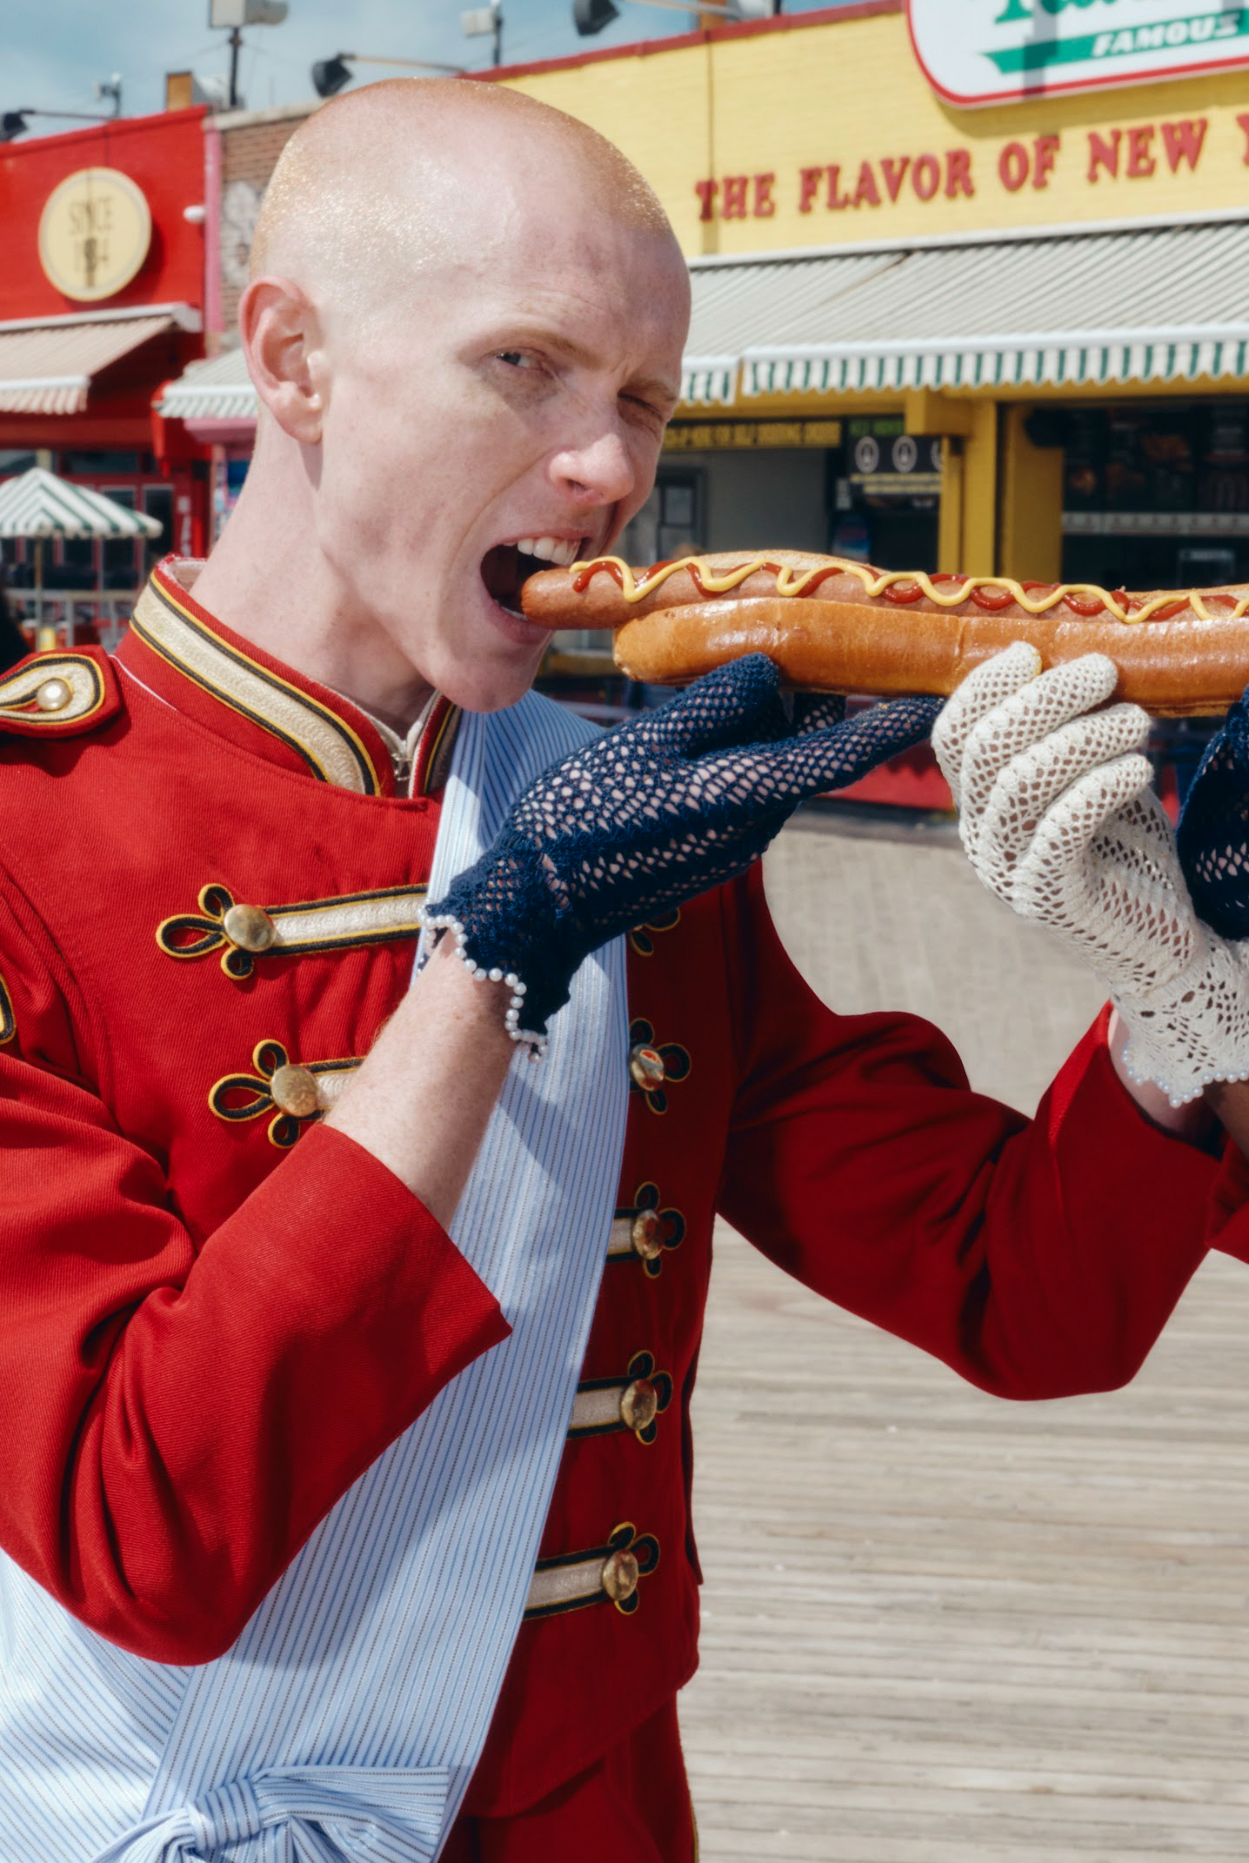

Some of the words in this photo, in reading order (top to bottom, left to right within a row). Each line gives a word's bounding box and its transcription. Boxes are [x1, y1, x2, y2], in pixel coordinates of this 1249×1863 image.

[1092, 12, 1243, 57] FAMOUS
[695, 172, 776, 222] THE
[797, 148, 976, 214] FLAVOR
[998, 133, 1062, 192] OF
[1086, 117, 1208, 183] NEW
